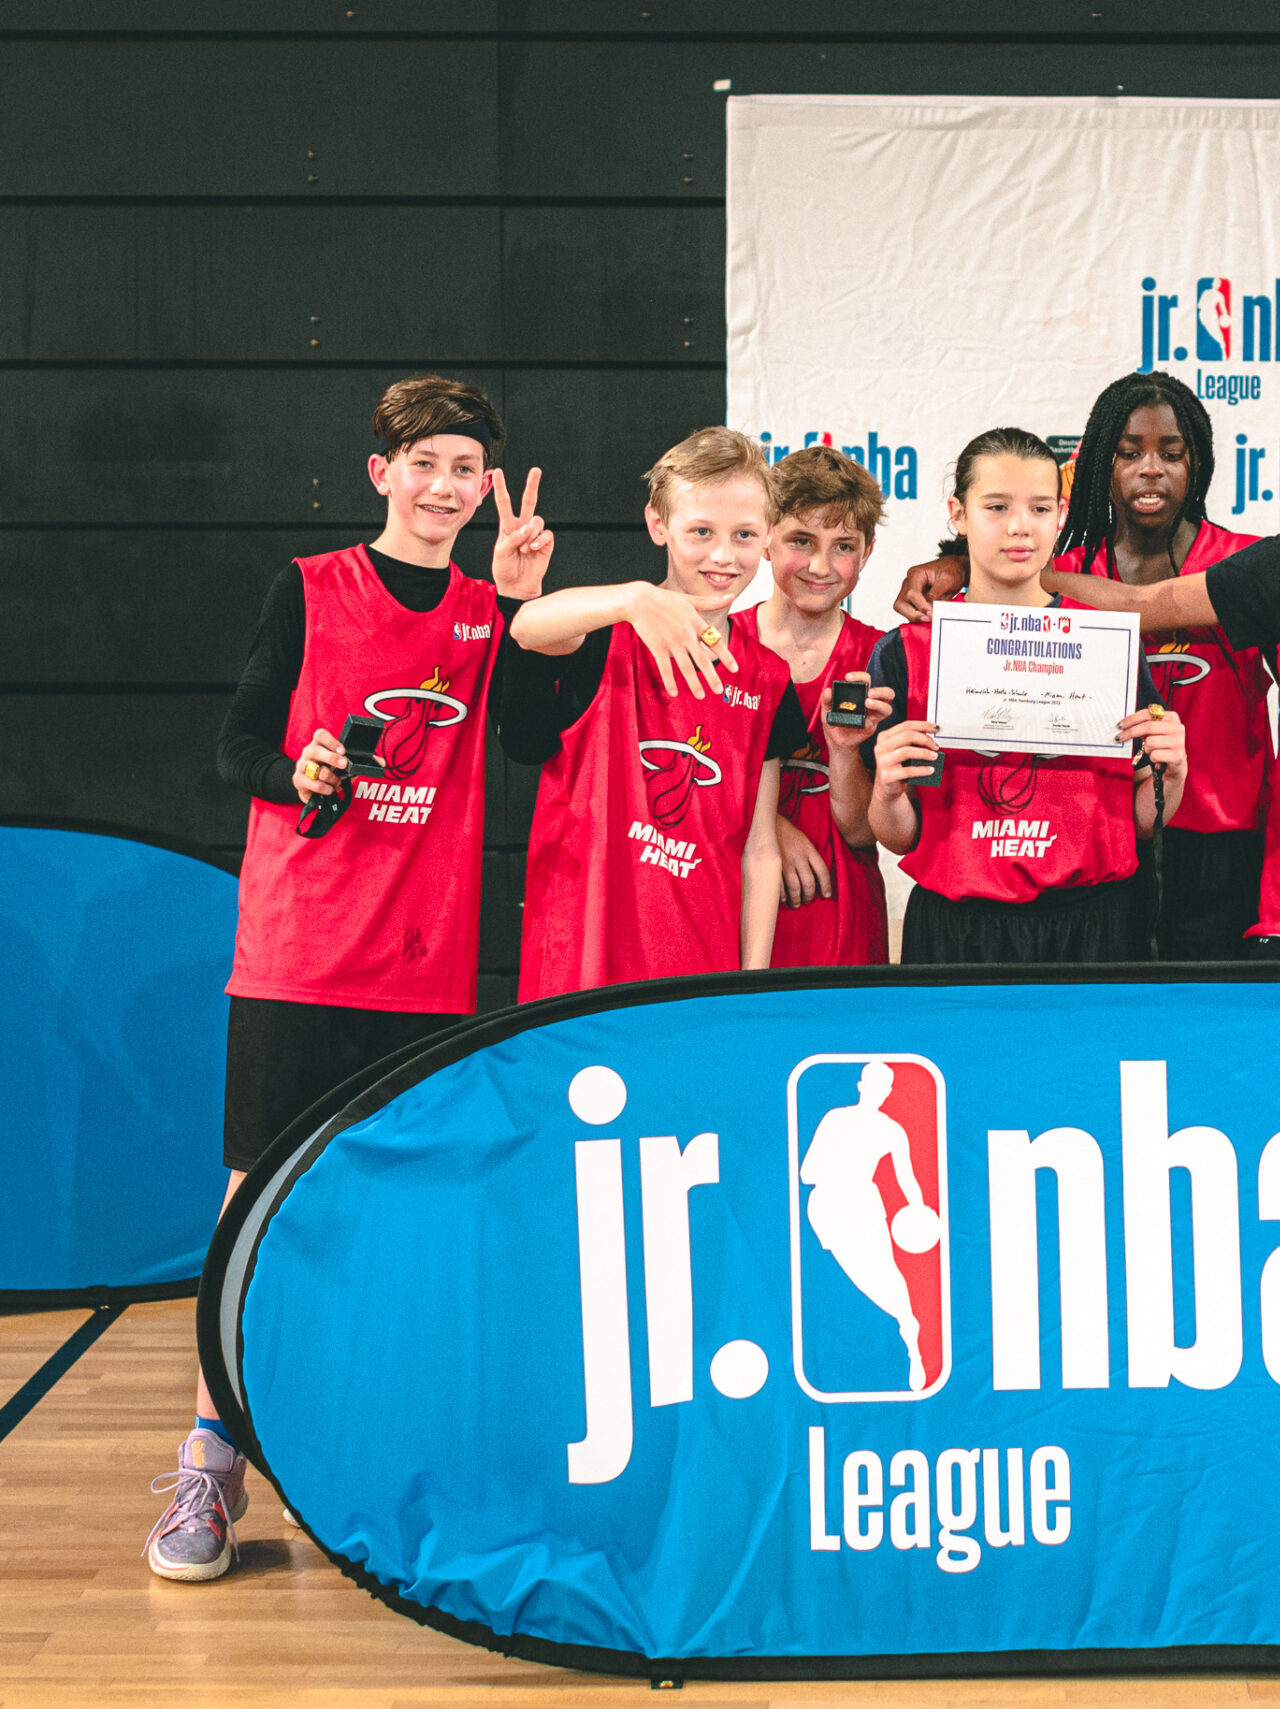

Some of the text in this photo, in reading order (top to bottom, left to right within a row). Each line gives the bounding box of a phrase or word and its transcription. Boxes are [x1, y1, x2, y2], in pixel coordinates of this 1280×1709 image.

[1137, 276, 1188, 375] jr.
[1196, 368, 1261, 406] League
[1231, 433, 1274, 515] jr.
[1009, 612, 1042, 634] jr.nba
[986, 638, 1082, 660] CONGRATULATIONS
[1028, 660, 1064, 676] Champion
[354, 781, 437, 805] MIAMI
[367, 802, 433, 825] HEAT
[971, 819, 1050, 839] MIAMI
[990, 833, 1058, 858] HEAT
[639, 844, 703, 879] HEAT
[567, 1064, 769, 1485] jr.
[808, 1425, 1072, 1574] League
